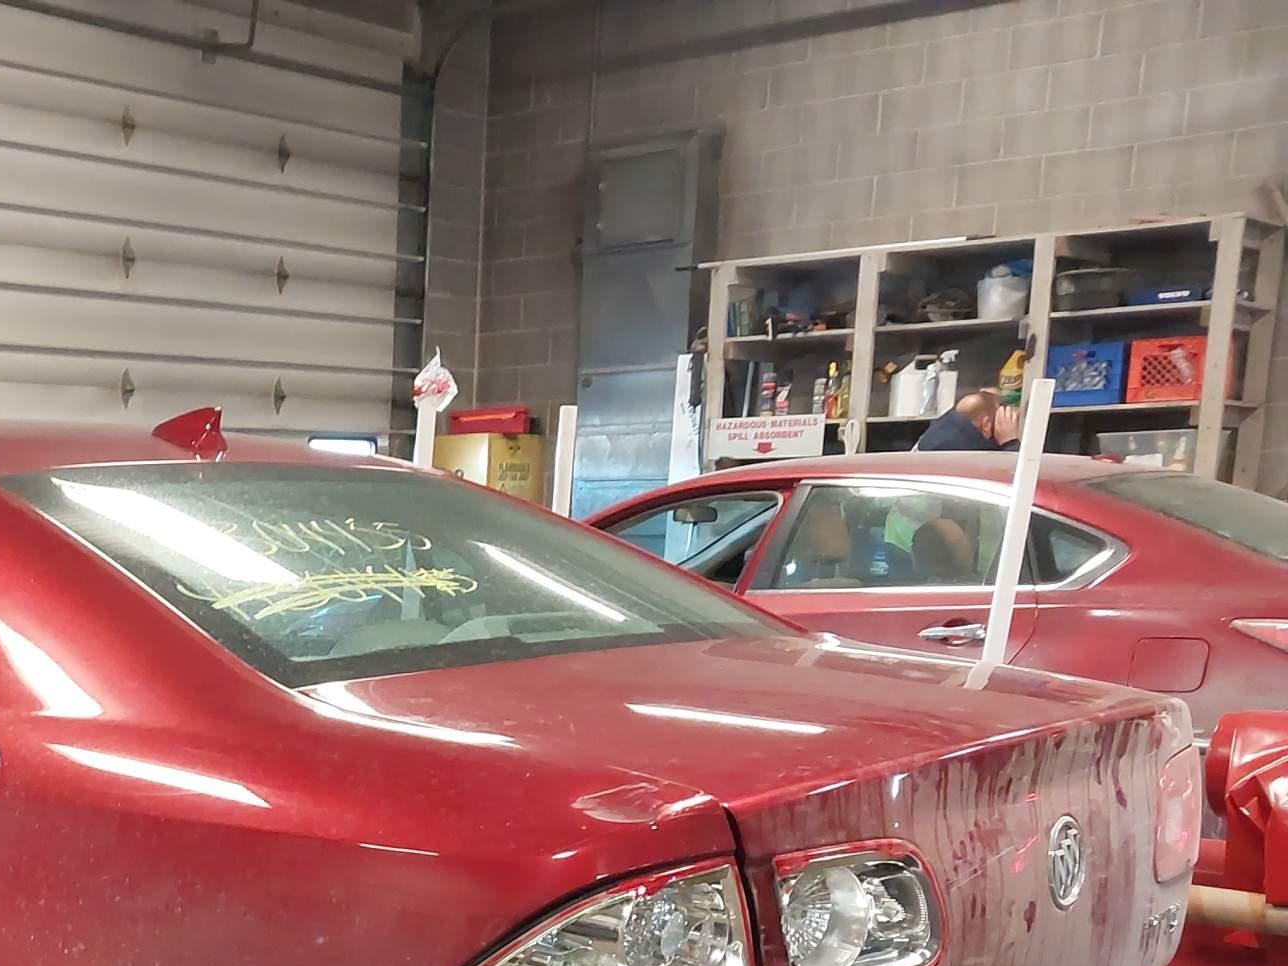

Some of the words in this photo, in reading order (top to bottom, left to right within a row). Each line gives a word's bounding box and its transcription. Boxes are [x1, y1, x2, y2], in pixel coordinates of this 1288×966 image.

[715, 420, 768, 430] HAZARDOUS
[771, 418, 818, 428] MATERIALS
[727, 432, 749, 441] SPILL
[753, 430, 805, 440] ABSORBENT
